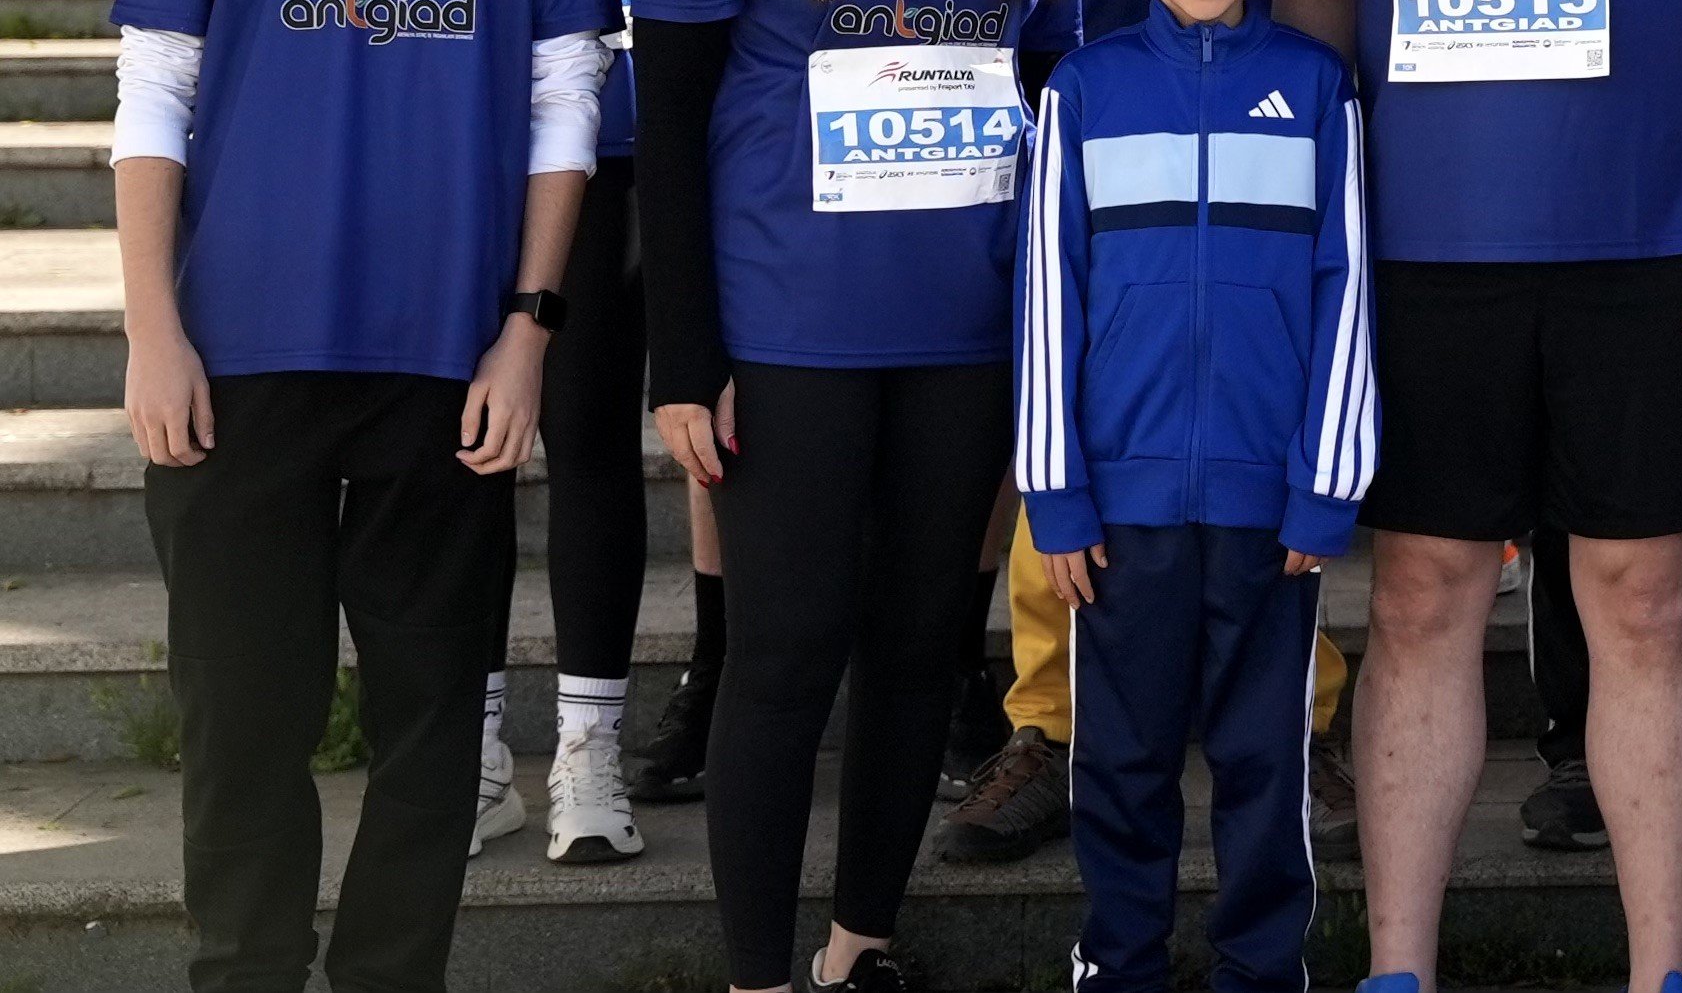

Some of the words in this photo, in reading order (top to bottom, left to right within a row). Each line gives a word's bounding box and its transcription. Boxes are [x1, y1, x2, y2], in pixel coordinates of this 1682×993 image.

[1418, 17, 1583, 32] ANTGIAD
[898, 70, 975, 82] RUNTALYA
[830, 109, 1018, 147] 10514
[843, 145, 1004, 162] ANTGIAD
